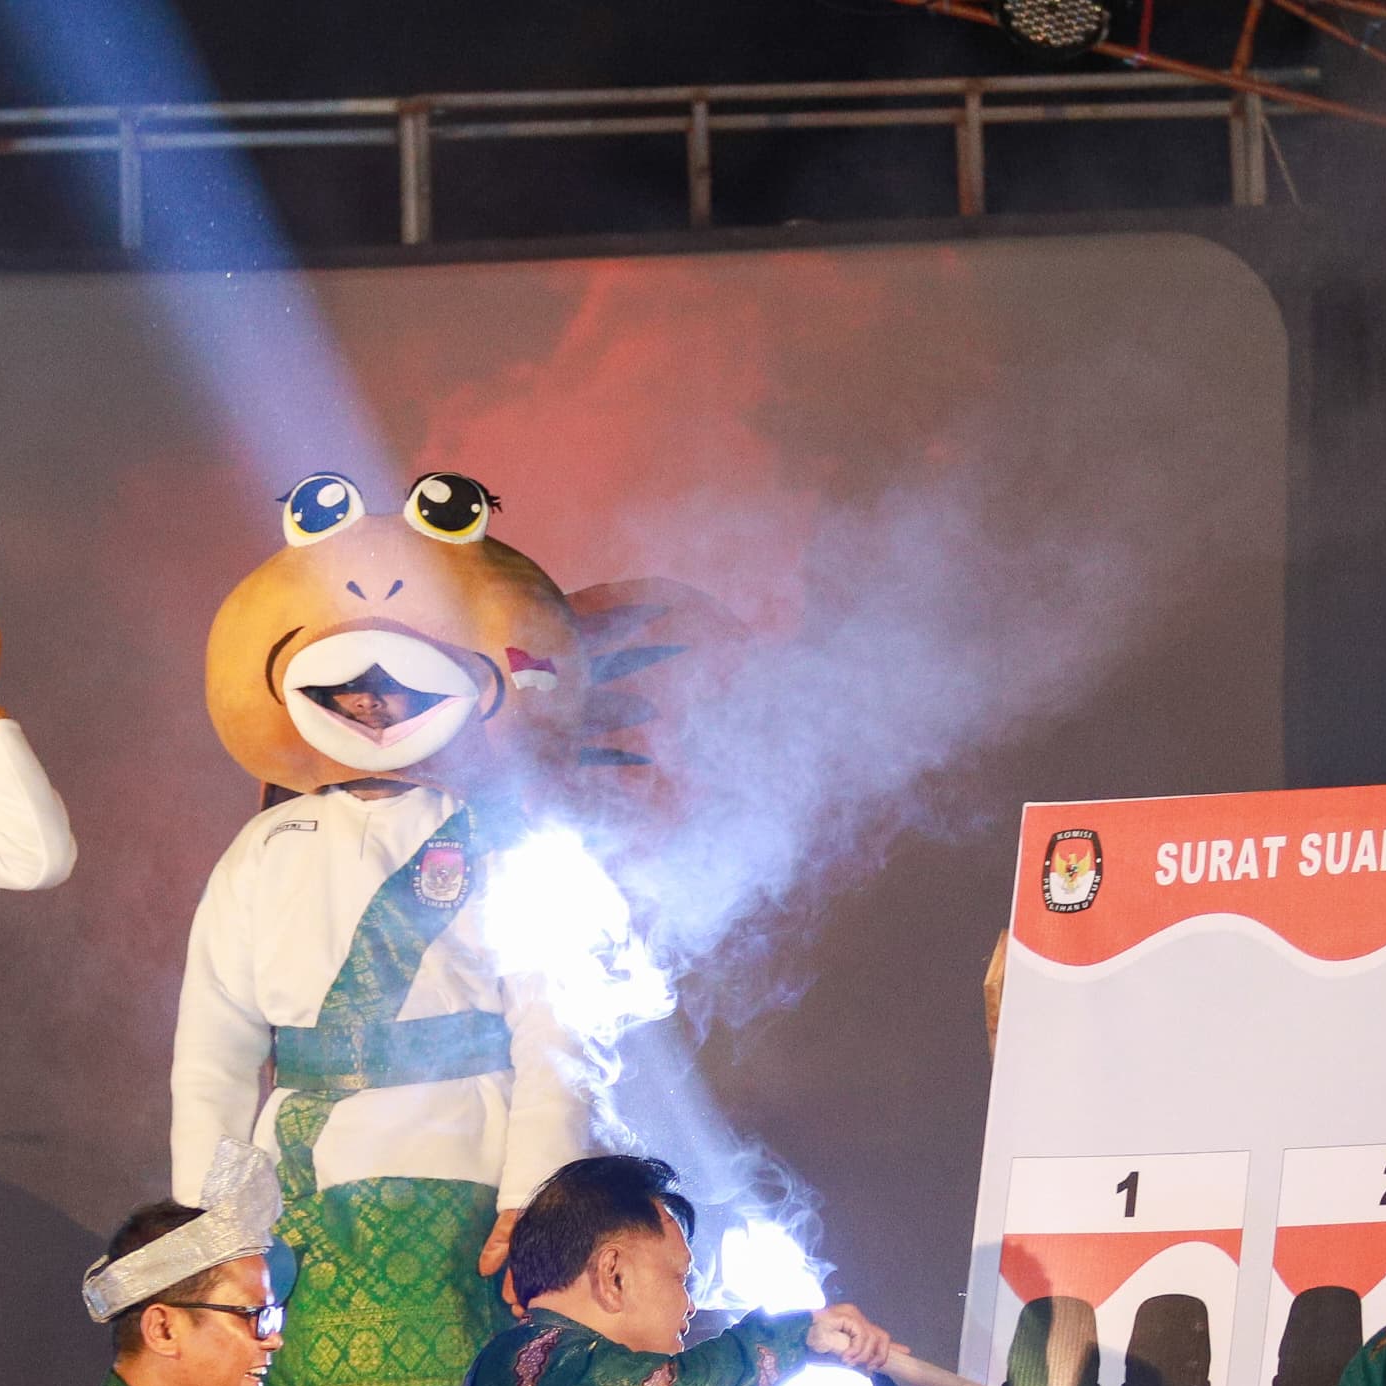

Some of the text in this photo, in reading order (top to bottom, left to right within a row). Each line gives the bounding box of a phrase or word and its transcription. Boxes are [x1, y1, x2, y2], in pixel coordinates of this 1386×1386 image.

[1056, 830, 1093, 841] KOMISI
[1154, 834, 1287, 886] SURAT
[1116, 1171, 1139, 1218] 1
